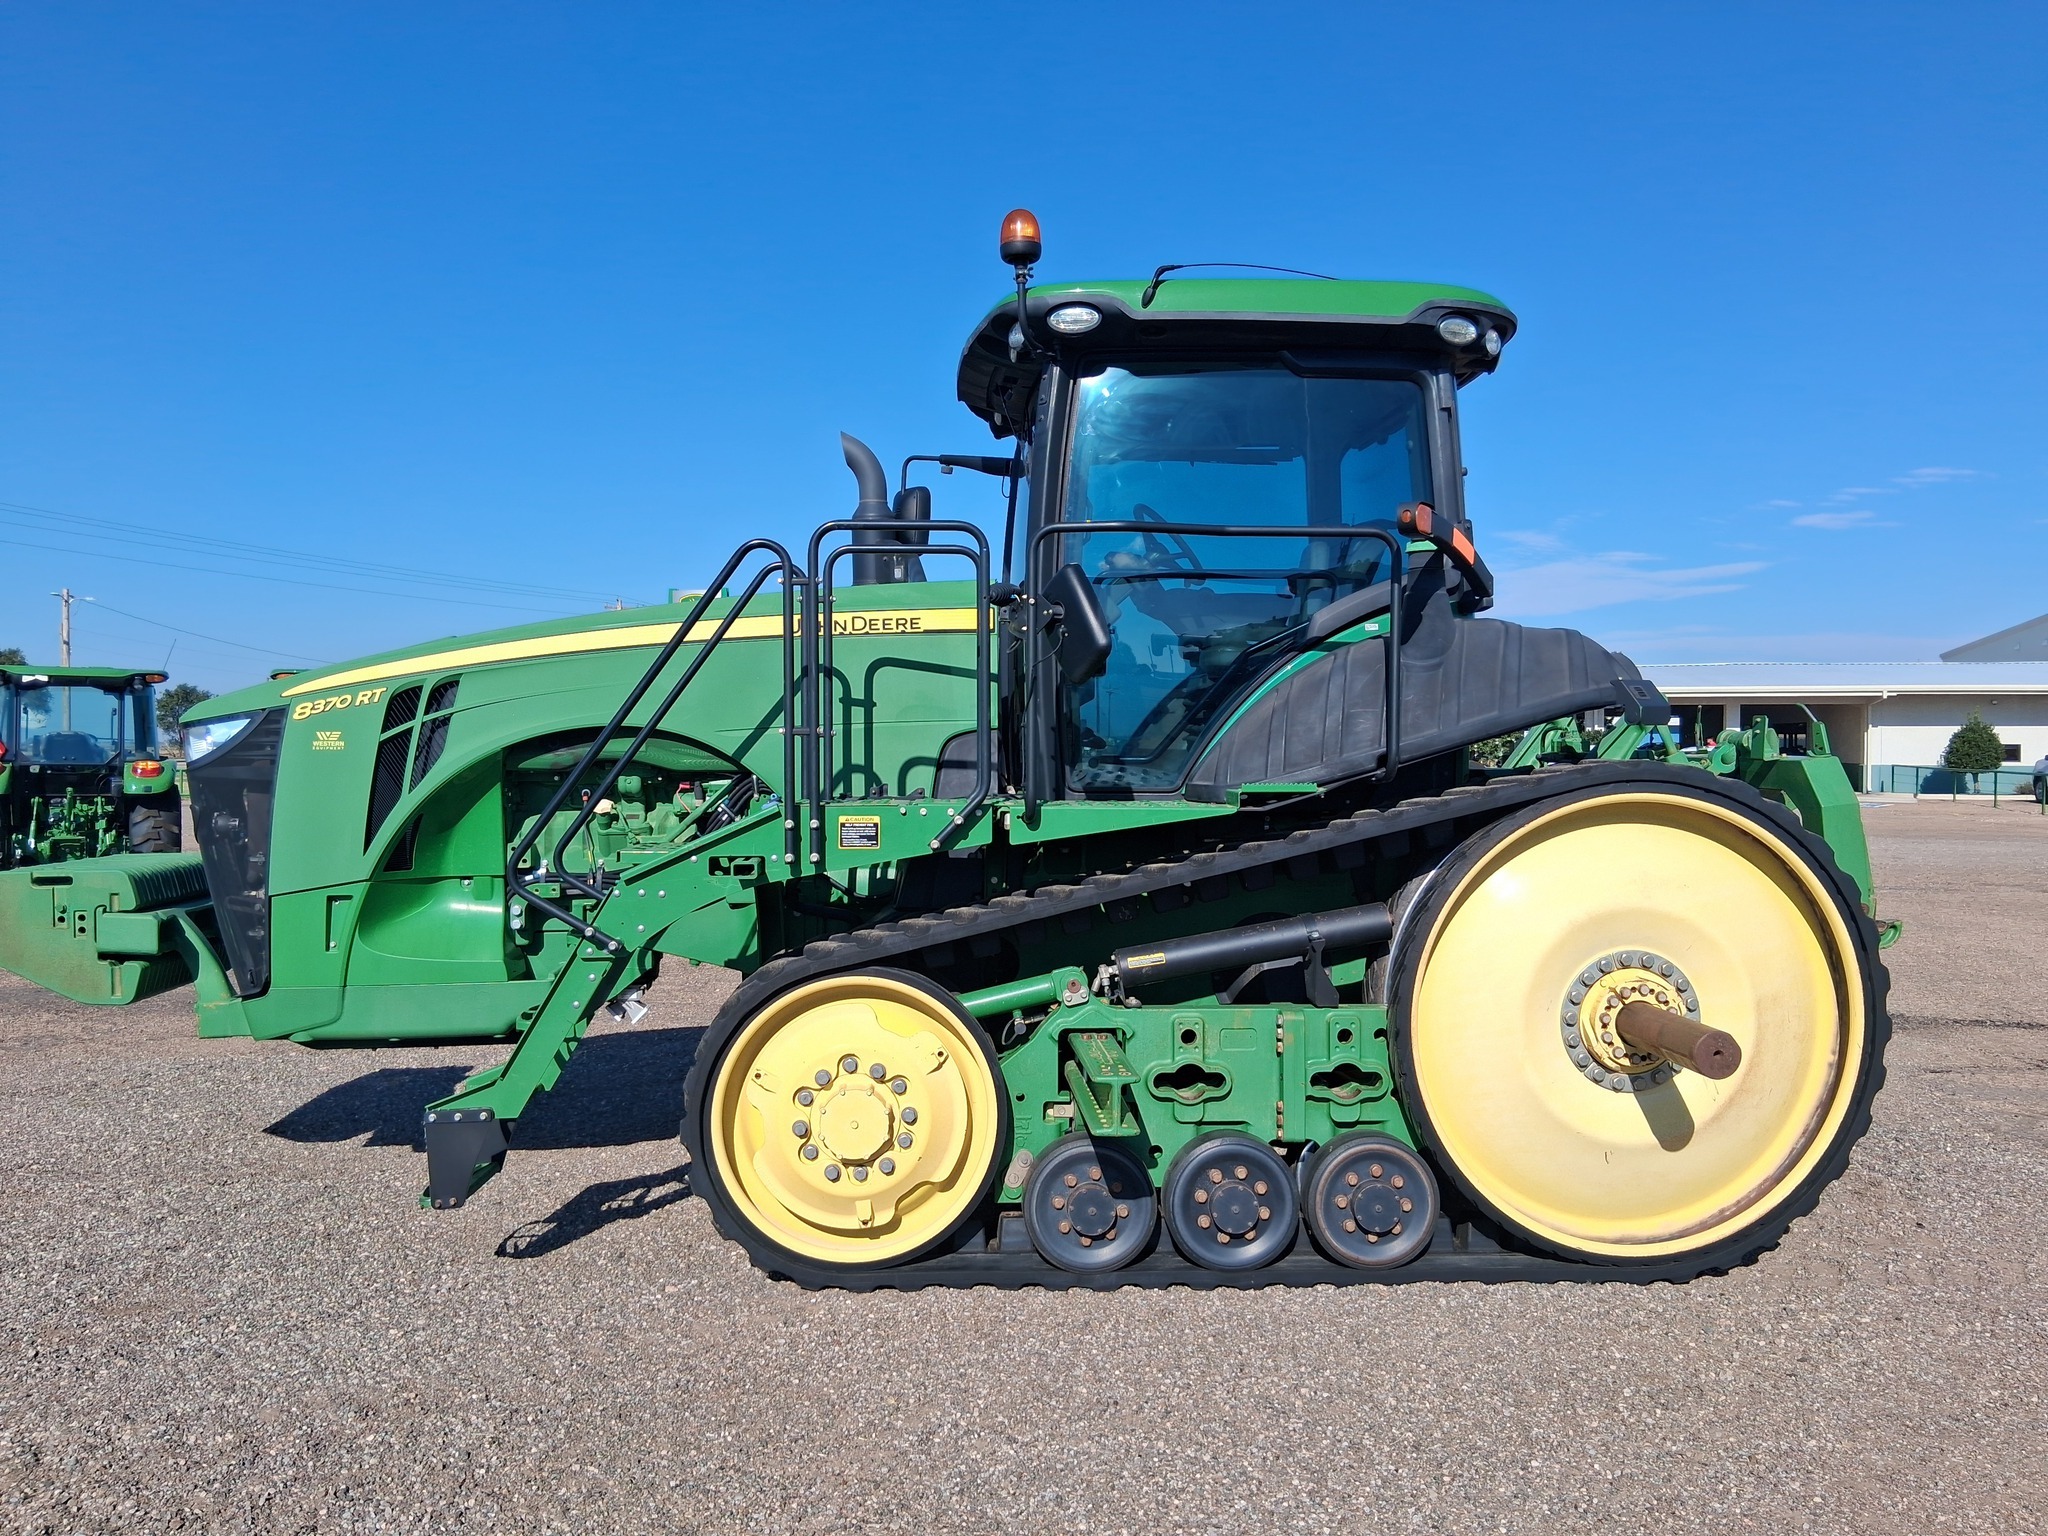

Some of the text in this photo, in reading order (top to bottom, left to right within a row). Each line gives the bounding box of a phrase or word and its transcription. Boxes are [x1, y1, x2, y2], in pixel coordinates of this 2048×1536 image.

[793, 616, 921, 634] JN DEERE
[293, 687, 388, 720] 8370 RT
